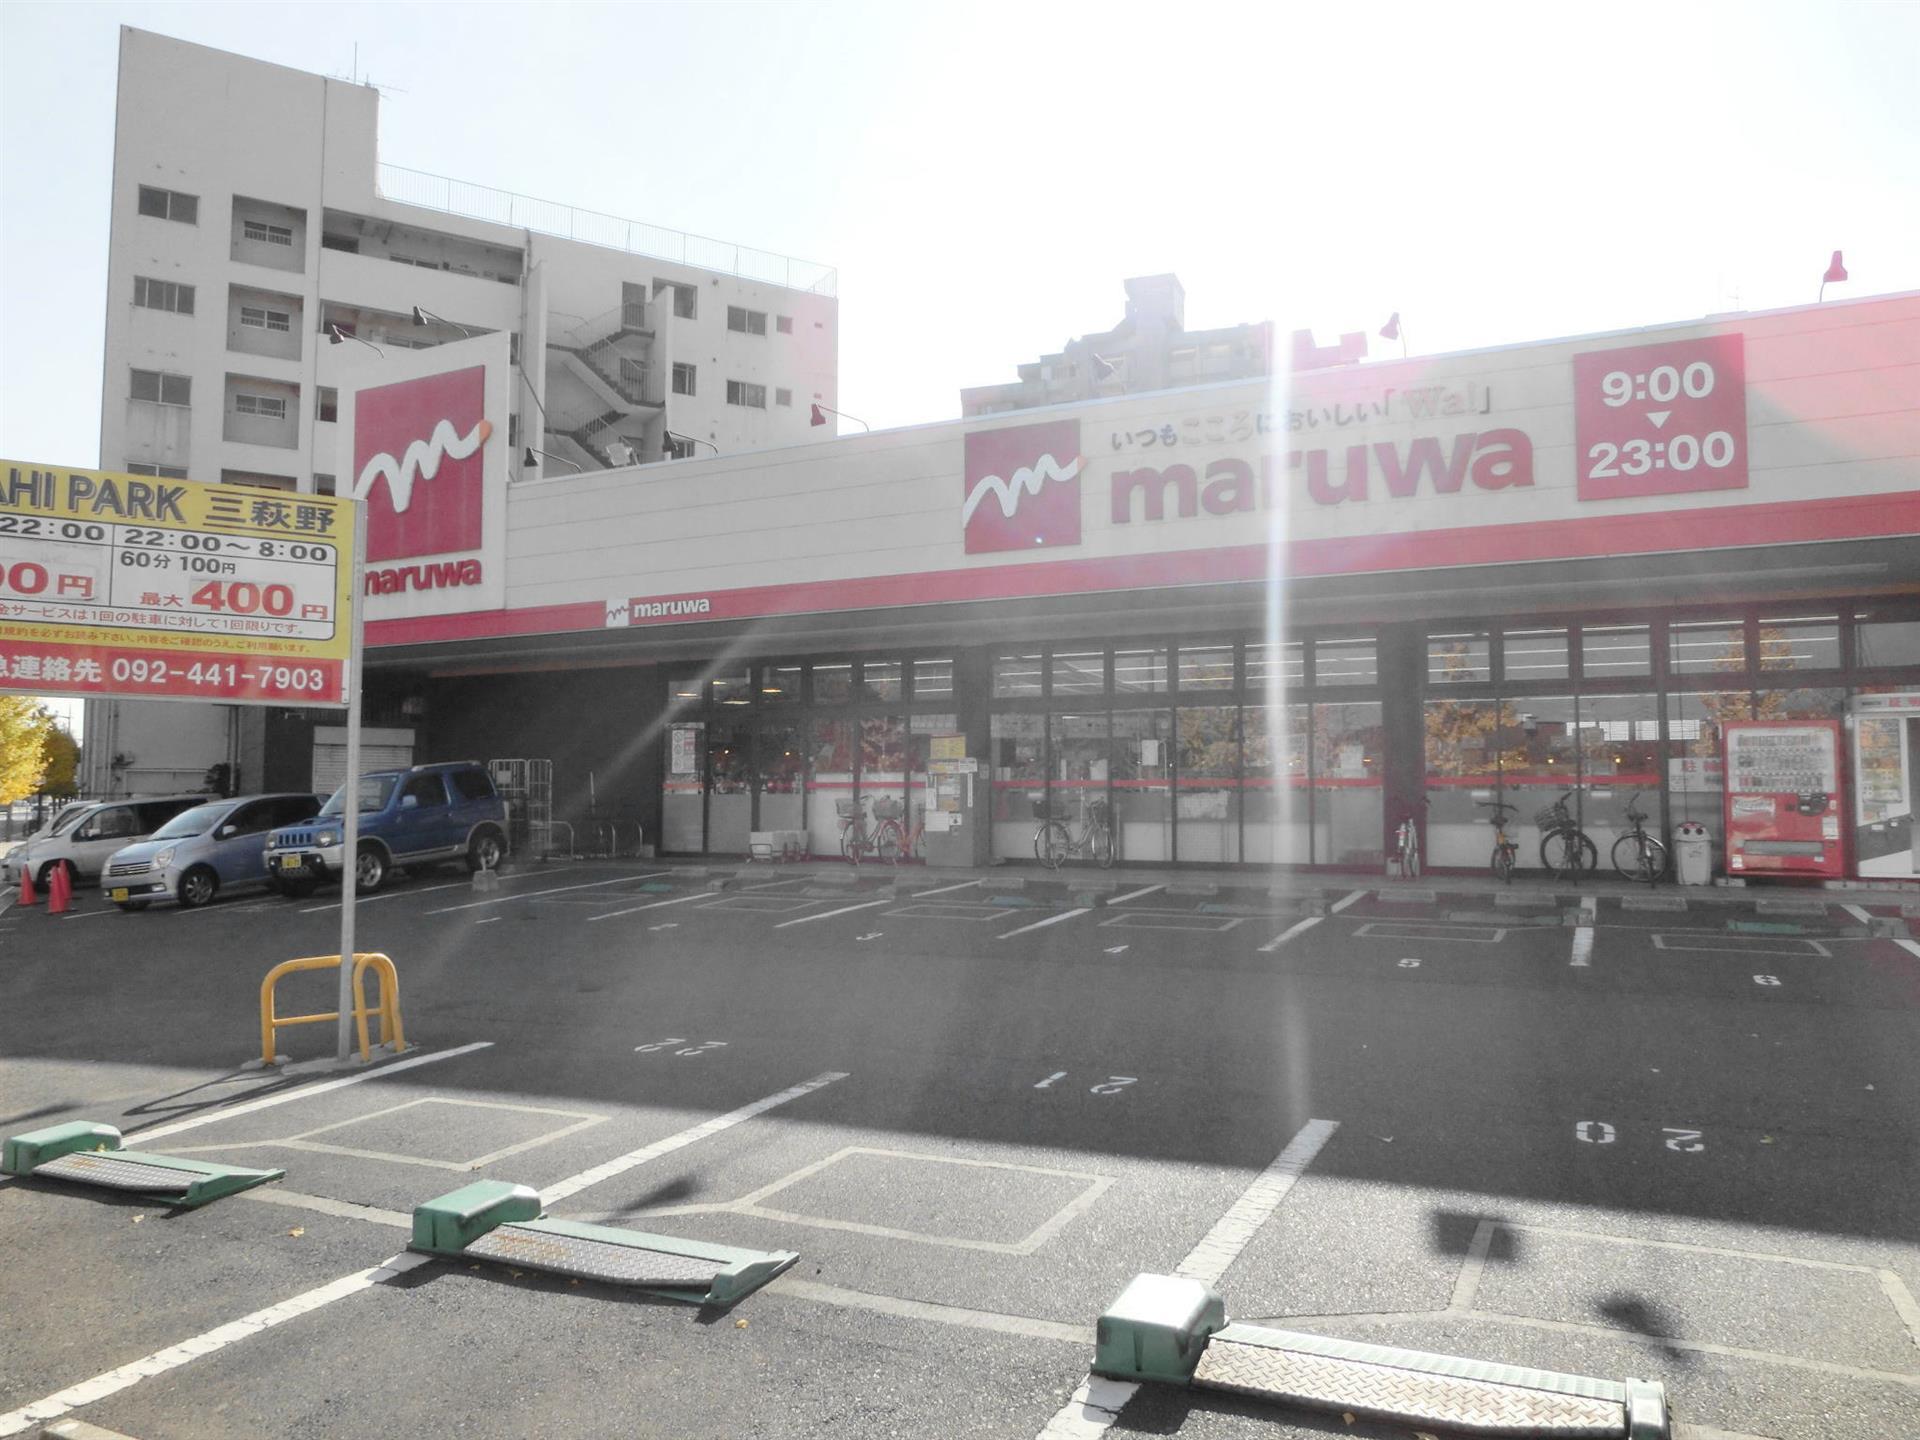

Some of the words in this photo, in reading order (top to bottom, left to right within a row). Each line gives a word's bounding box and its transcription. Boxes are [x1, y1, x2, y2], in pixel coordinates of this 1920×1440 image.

[1602, 361, 1716, 408] 9:00
[1109, 422, 1536, 525] maruwa
[1588, 430, 1736, 480] 23:00
[68, 475, 187, 525] PARK
[205, 497, 337, 534] 三萩野
[633, 598, 710, 618] maruwa
[112, 658, 324, 691] 092-441-7903
